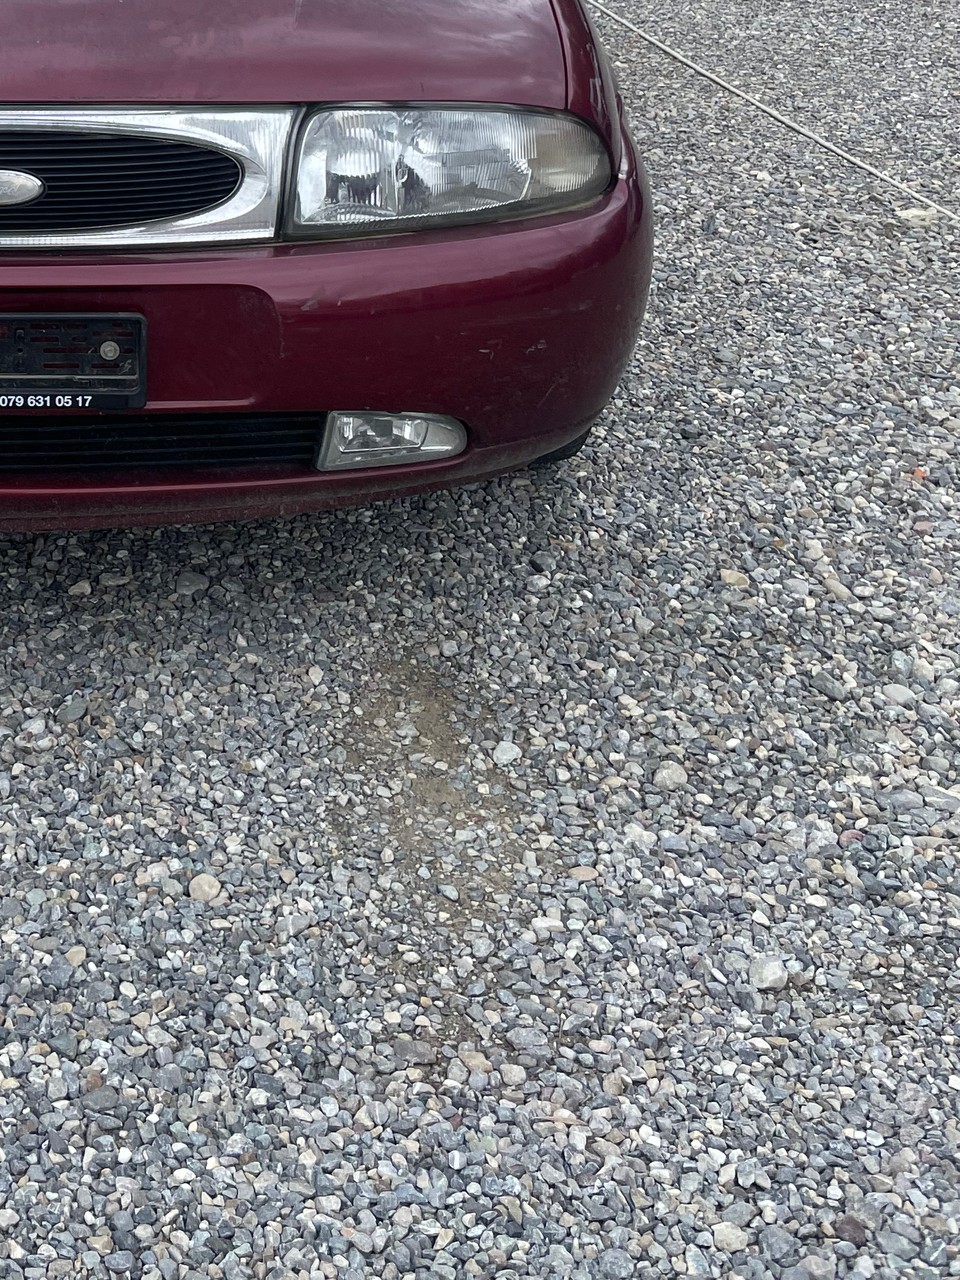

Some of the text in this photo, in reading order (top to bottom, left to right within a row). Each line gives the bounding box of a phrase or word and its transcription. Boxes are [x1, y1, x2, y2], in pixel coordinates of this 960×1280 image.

[0, 396, 24, 407] 079
[27, 396, 51, 407] 631
[55, 396, 72, 407] 05
[76, 396, 92, 407] 17
